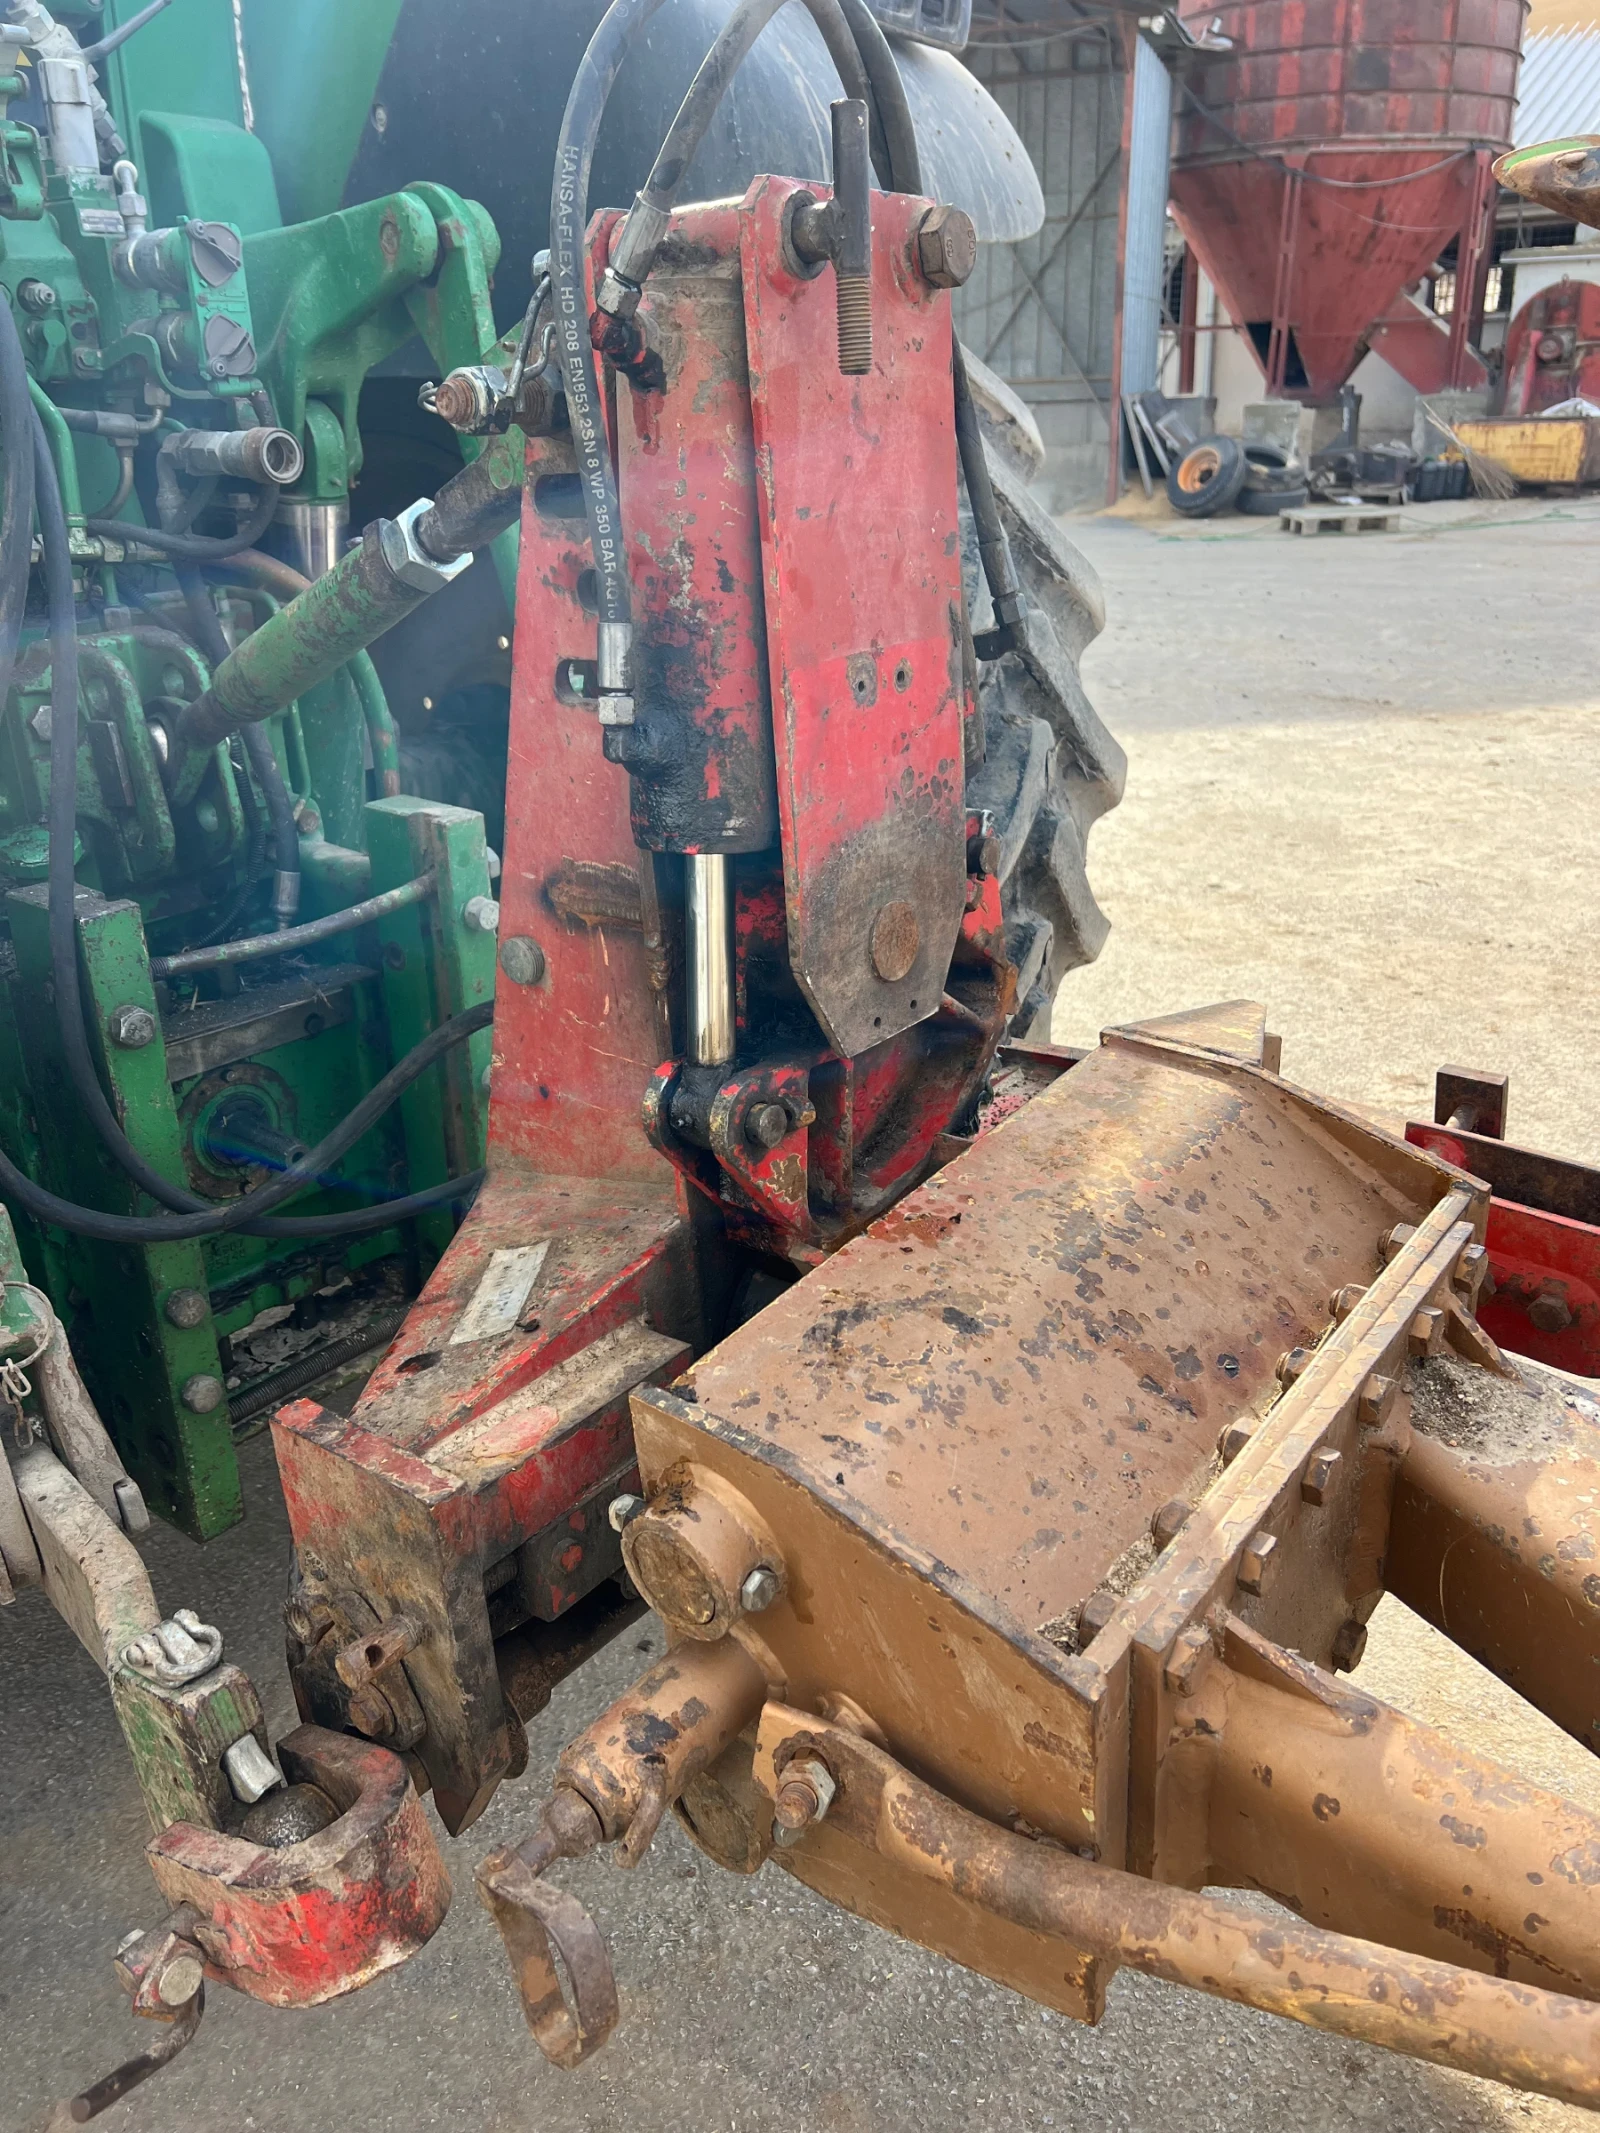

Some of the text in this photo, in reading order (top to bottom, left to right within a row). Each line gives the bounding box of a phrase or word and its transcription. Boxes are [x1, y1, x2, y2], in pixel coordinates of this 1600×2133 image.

[558, 145, 579, 277] HANSA-FLEX
[560, 287, 574, 314] HD
[564, 320, 579, 351] 208
[569, 357, 589, 413] EN853
[580, 418, 597, 453] 2SN
[590, 470, 605, 500] WP
[595, 504, 611, 534] 350
[600, 538, 616, 574] BAR
